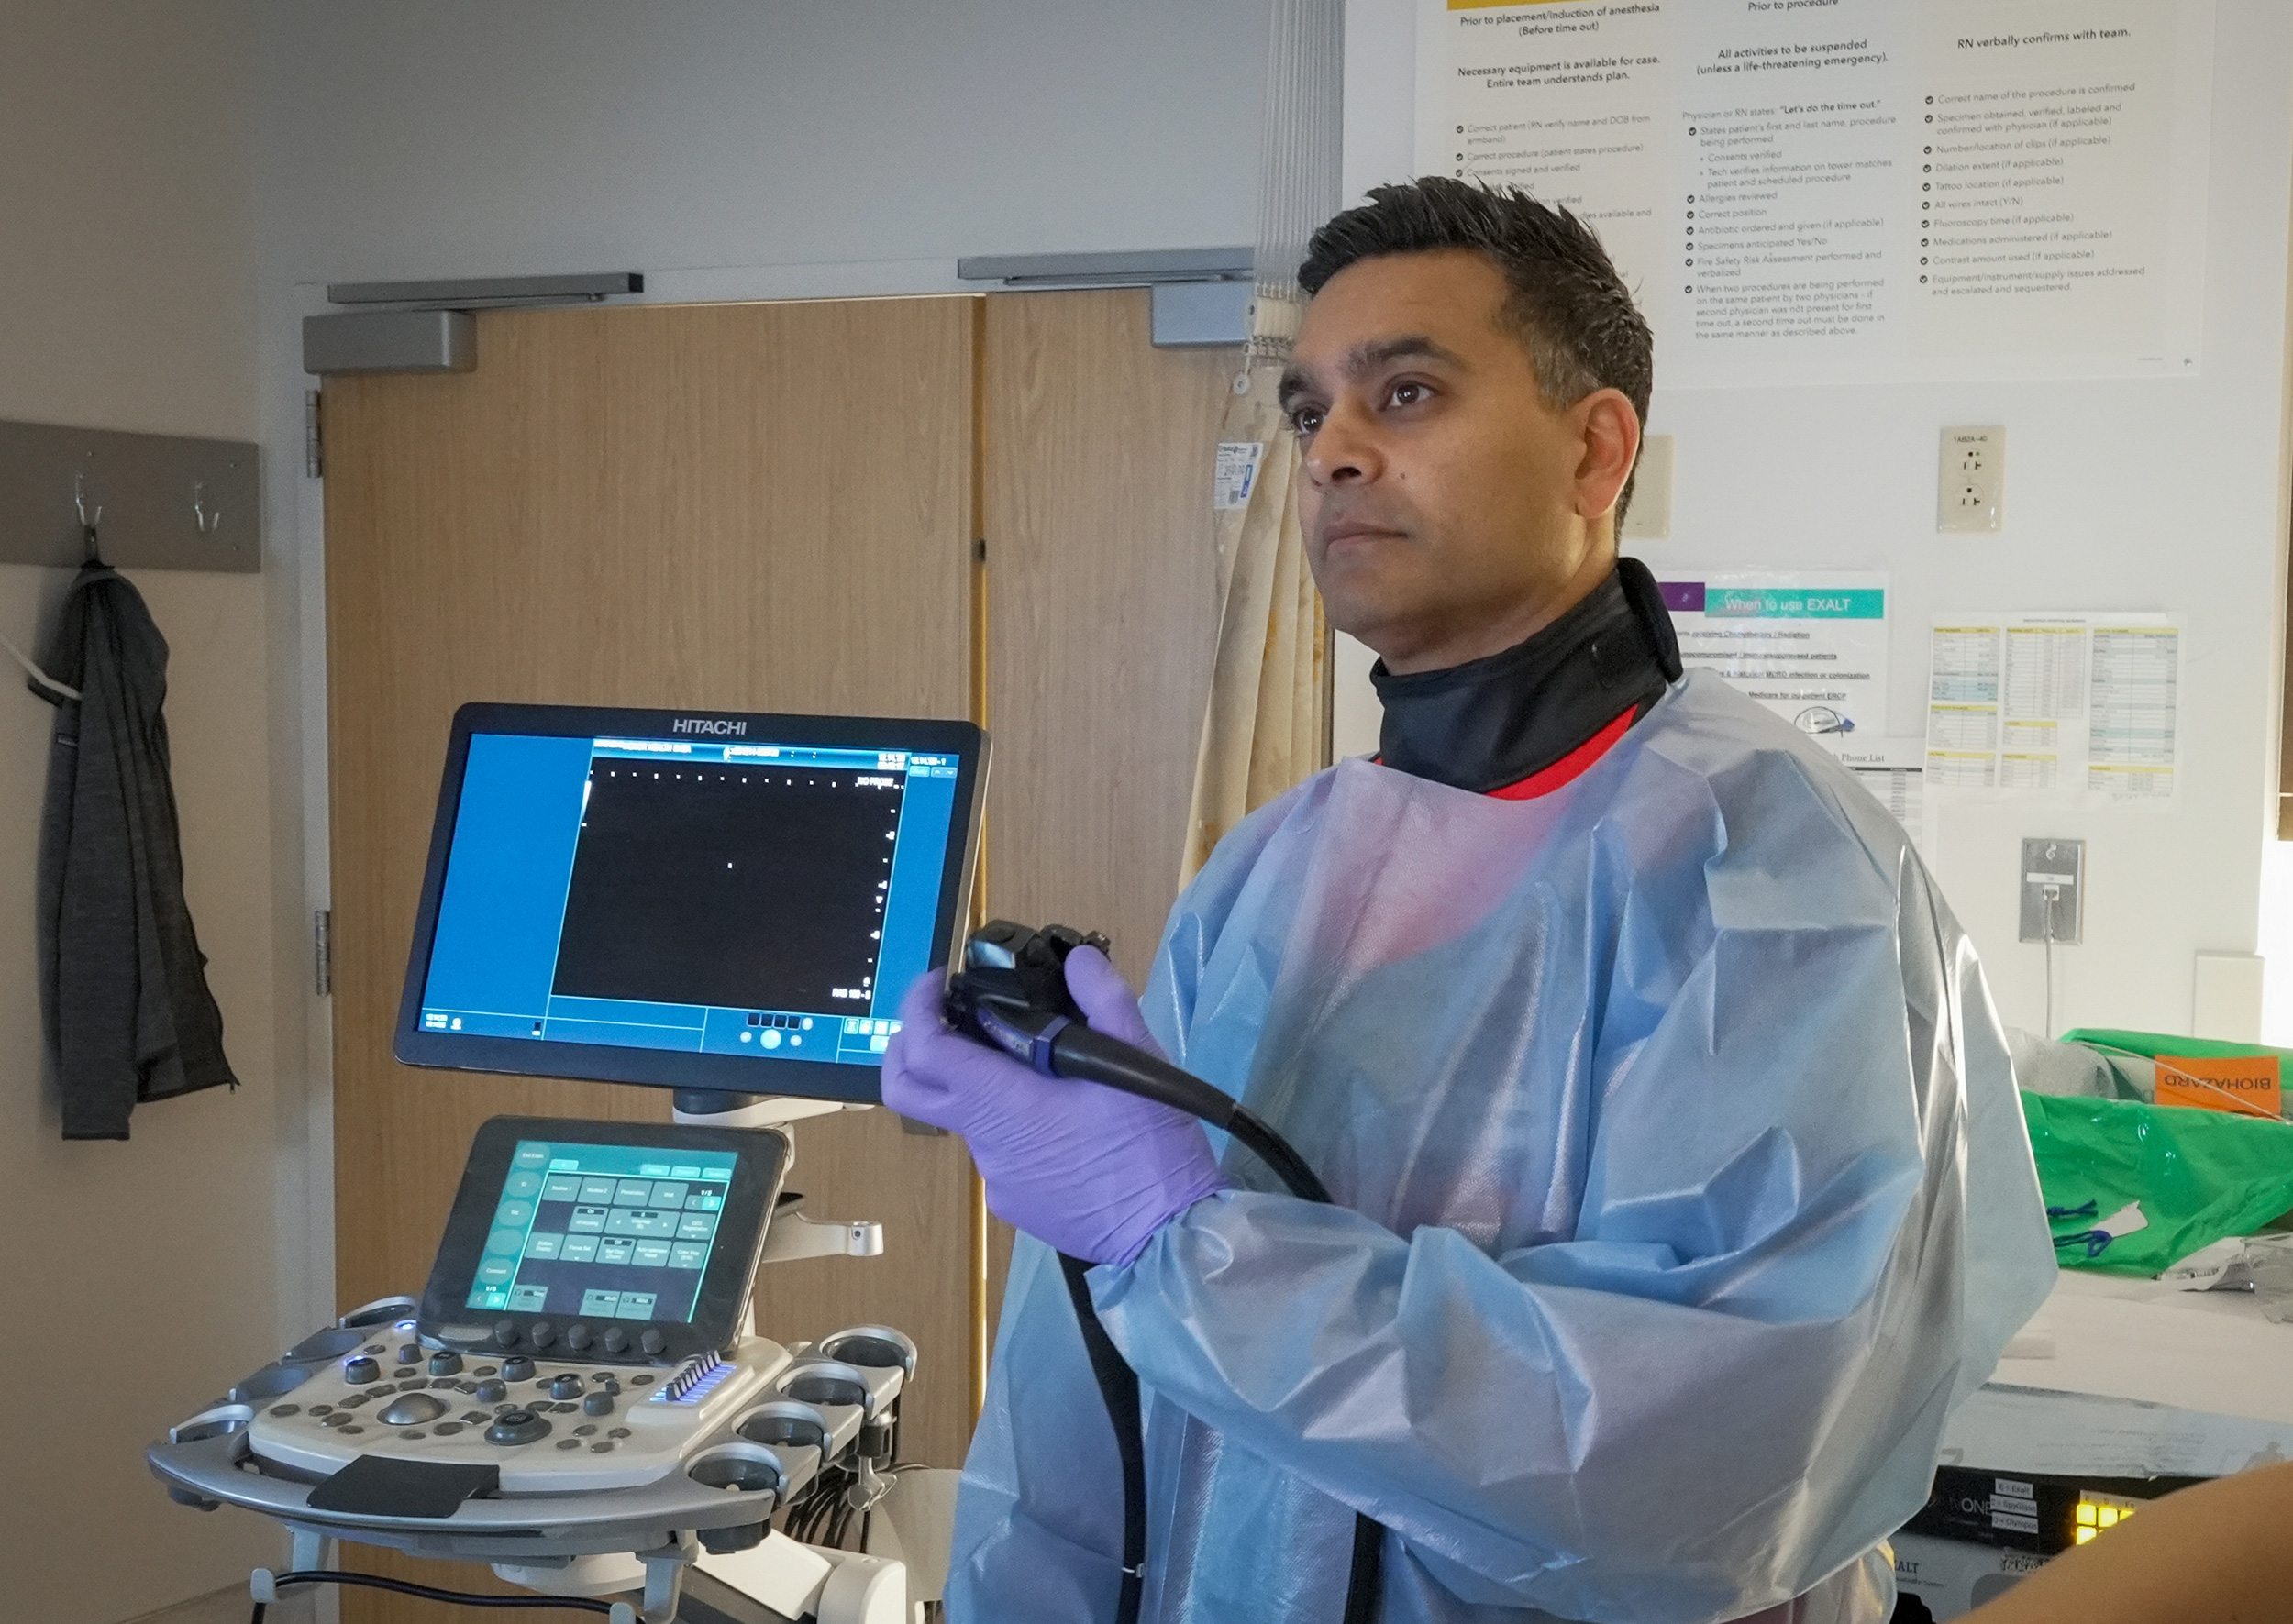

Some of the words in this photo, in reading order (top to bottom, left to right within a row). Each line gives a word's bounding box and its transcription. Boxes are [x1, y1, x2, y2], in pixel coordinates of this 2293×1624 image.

[1748, 1, 1771, 11] Prior
[1773, 0, 1784, 9] to
[1460, 16, 1481, 27] Prior
[1484, 15, 1494, 25] to
[1496, 7, 1594, 26] placement/induction
[1596, 6, 1606, 17] of
[1609, 3, 1660, 16] anesthesia
[1519, 25, 1554, 39] (Before
[1556, 23, 1577, 33] time
[1579, 21, 1600, 33] out)
[1957, 38, 1974, 49] RN
[1976, 35, 2020, 48] verbally
[2022, 33, 2069, 44] confirms
[2072, 30, 2096, 41] with
[2099, 29, 2132, 39] team.
[1718, 49, 1731, 59] All
[1734, 46, 1778, 58] activities
[1780, 45, 1791, 55] to
[1794, 44, 1807, 54] be
[1810, 39, 1867, 54] suspended
[1457, 66, 1506, 77] Necessary
[1508, 61, 1561, 75] equipment
[1563, 60, 1570, 70] is
[1573, 57, 1617, 70] available
[1619, 56, 1633, 66] for
[1635, 57, 1661, 65] case.
[1697, 63, 1732, 76] (unless
[1743, 57, 1821, 72] life-threatening
[1823, 53, 1888, 67] emergency).
[1487, 78, 1514, 88] Entire
[1516, 76, 1541, 86] team
[1544, 72, 1603, 85] understands
[1605, 71, 1630, 83] plan.
[1938, 94, 1971, 104] Correct
[1973, 94, 1999, 102] name
[2000, 91, 2010, 100] of
[2011, 90, 2027, 99] the
[2028, 87, 2077, 100] procedure
[2078, 86, 2086, 95] is
[2088, 83, 2136, 94] confirmed
[1682, 109, 1721, 122] Physician
[1734, 107, 1747, 116] RN
[1806, 103, 1819, 112] do
[1820, 102, 1835, 111] the
[1836, 101, 1857, 110] time
[1937, 112, 1981, 125] Specimen
[2066, 104, 2101, 115] labeled
[2103, 103, 2122, 113] and
[1700, 126, 1726, 135] States
[1728, 123, 1764, 136] patient's
[1766, 122, 1782, 131] first
[1784, 120, 1801, 130] and
[1803, 119, 1818, 129] last
[1849, 116, 1897, 128] procedure
[1937, 124, 1982, 135] confirmed
[1984, 122, 2003, 132] with
[2005, 120, 2047, 133] physician
[2048, 119, 2058, 130] (if
[2060, 116, 2112, 129] applicable)
[1700, 137, 1725, 148] being
[1726, 134, 1774, 148] performed
[1936, 141, 2011, 153] Number/location
[2014, 140, 2023, 149] of
[2025, 139, 2046, 150] clips
[2047, 138, 2057, 149] (if
[2059, 136, 2111, 149] applicable)
[1708, 151, 1747, 162] Consents
[1749, 149, 1782, 160] verified
[1708, 166, 1727, 176] Tech
[1729, 165, 1760, 175] verifies
[1762, 162, 1811, 173] information
[1827, 161, 1852, 170] tower
[1855, 159, 1892, 169] matches
[1935, 162, 1970, 172] Dilation
[1972, 160, 1999, 171] extent
[2001, 160, 2011, 171] (if
[2012, 157, 2064, 171] applicable)
[1708, 177, 1737, 190] patient
[1739, 176, 1756, 186] and
[1757, 174, 1803, 185] scheduled
[1805, 172, 1851, 185] procedure
[1699, 193, 1736, 204] Allergies
[1738, 191, 1778, 201] reviewed
[1934, 200, 1946, 209] All
[1948, 199, 1971, 209] wires
[1973, 197, 1998, 207] intact
[1999, 196, 2024, 208] (Y/N)
[1699, 209, 1730, 219] Correct
[1732, 207, 1767, 220] position
[1698, 240, 1745, 252] Specimens
[1745, 238, 1795, 249] anticipated
[1796, 237, 1828, 246] Yes/No
[1697, 257, 1713, 266] Fire
[1715, 256, 1741, 267] Safety
[1743, 255, 1759, 264] Risk
[1762, 252, 1813, 263] Assessment
[1815, 250, 1863, 263] performed
[1865, 249, 1882, 259] and
[1697, 267, 1741, 277] verbalized
[1932, 270, 2064, 286] Equipment/instrument/supply
[2066, 270, 2094, 279] issues
[2096, 266, 2145, 277] addressed
[1932, 286, 1948, 295] and
[1950, 284, 1992, 294] escalated
[1994, 283, 2012, 293] and
[2013, 282, 2071, 294] sequestered
[1726, 598, 1762, 611] When
[1765, 599, 1778, 611] to
[1781, 601, 1803, 611] use
[1807, 598, 1851, 611] EXALT
[672, 719, 748, 735] HITACHI
[1842, 753, 1867, 761] Phone
[1869, 754, 1884, 762] List
[2165, 1075, 2271, 1090] BIOHAZARD
